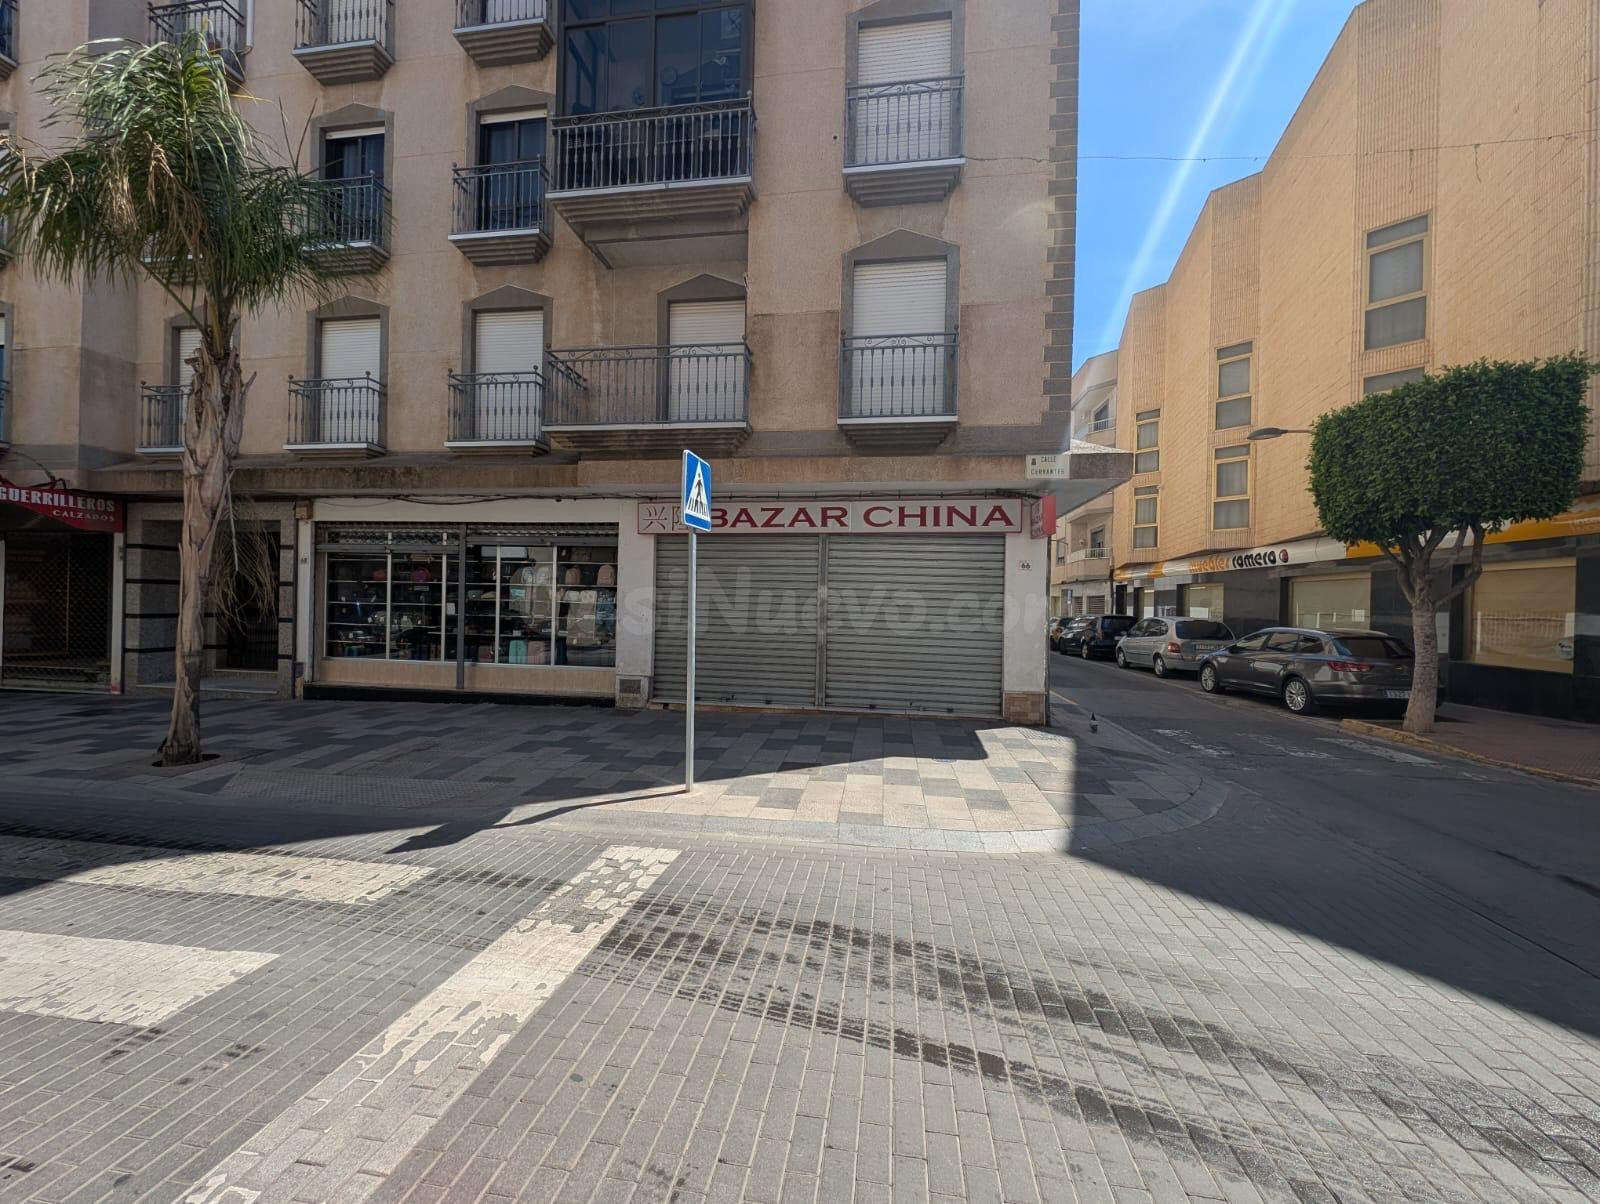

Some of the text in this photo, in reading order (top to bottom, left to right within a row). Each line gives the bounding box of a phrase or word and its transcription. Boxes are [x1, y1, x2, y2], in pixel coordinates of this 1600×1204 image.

[1040, 455, 1057, 463] CALLE
[0, 486, 115, 512] GUERRILLEROS
[52, 509, 115, 522] CALZADOS
[711, 506, 849, 528] BAZAR
[863, 505, 1015, 528] CHINA
